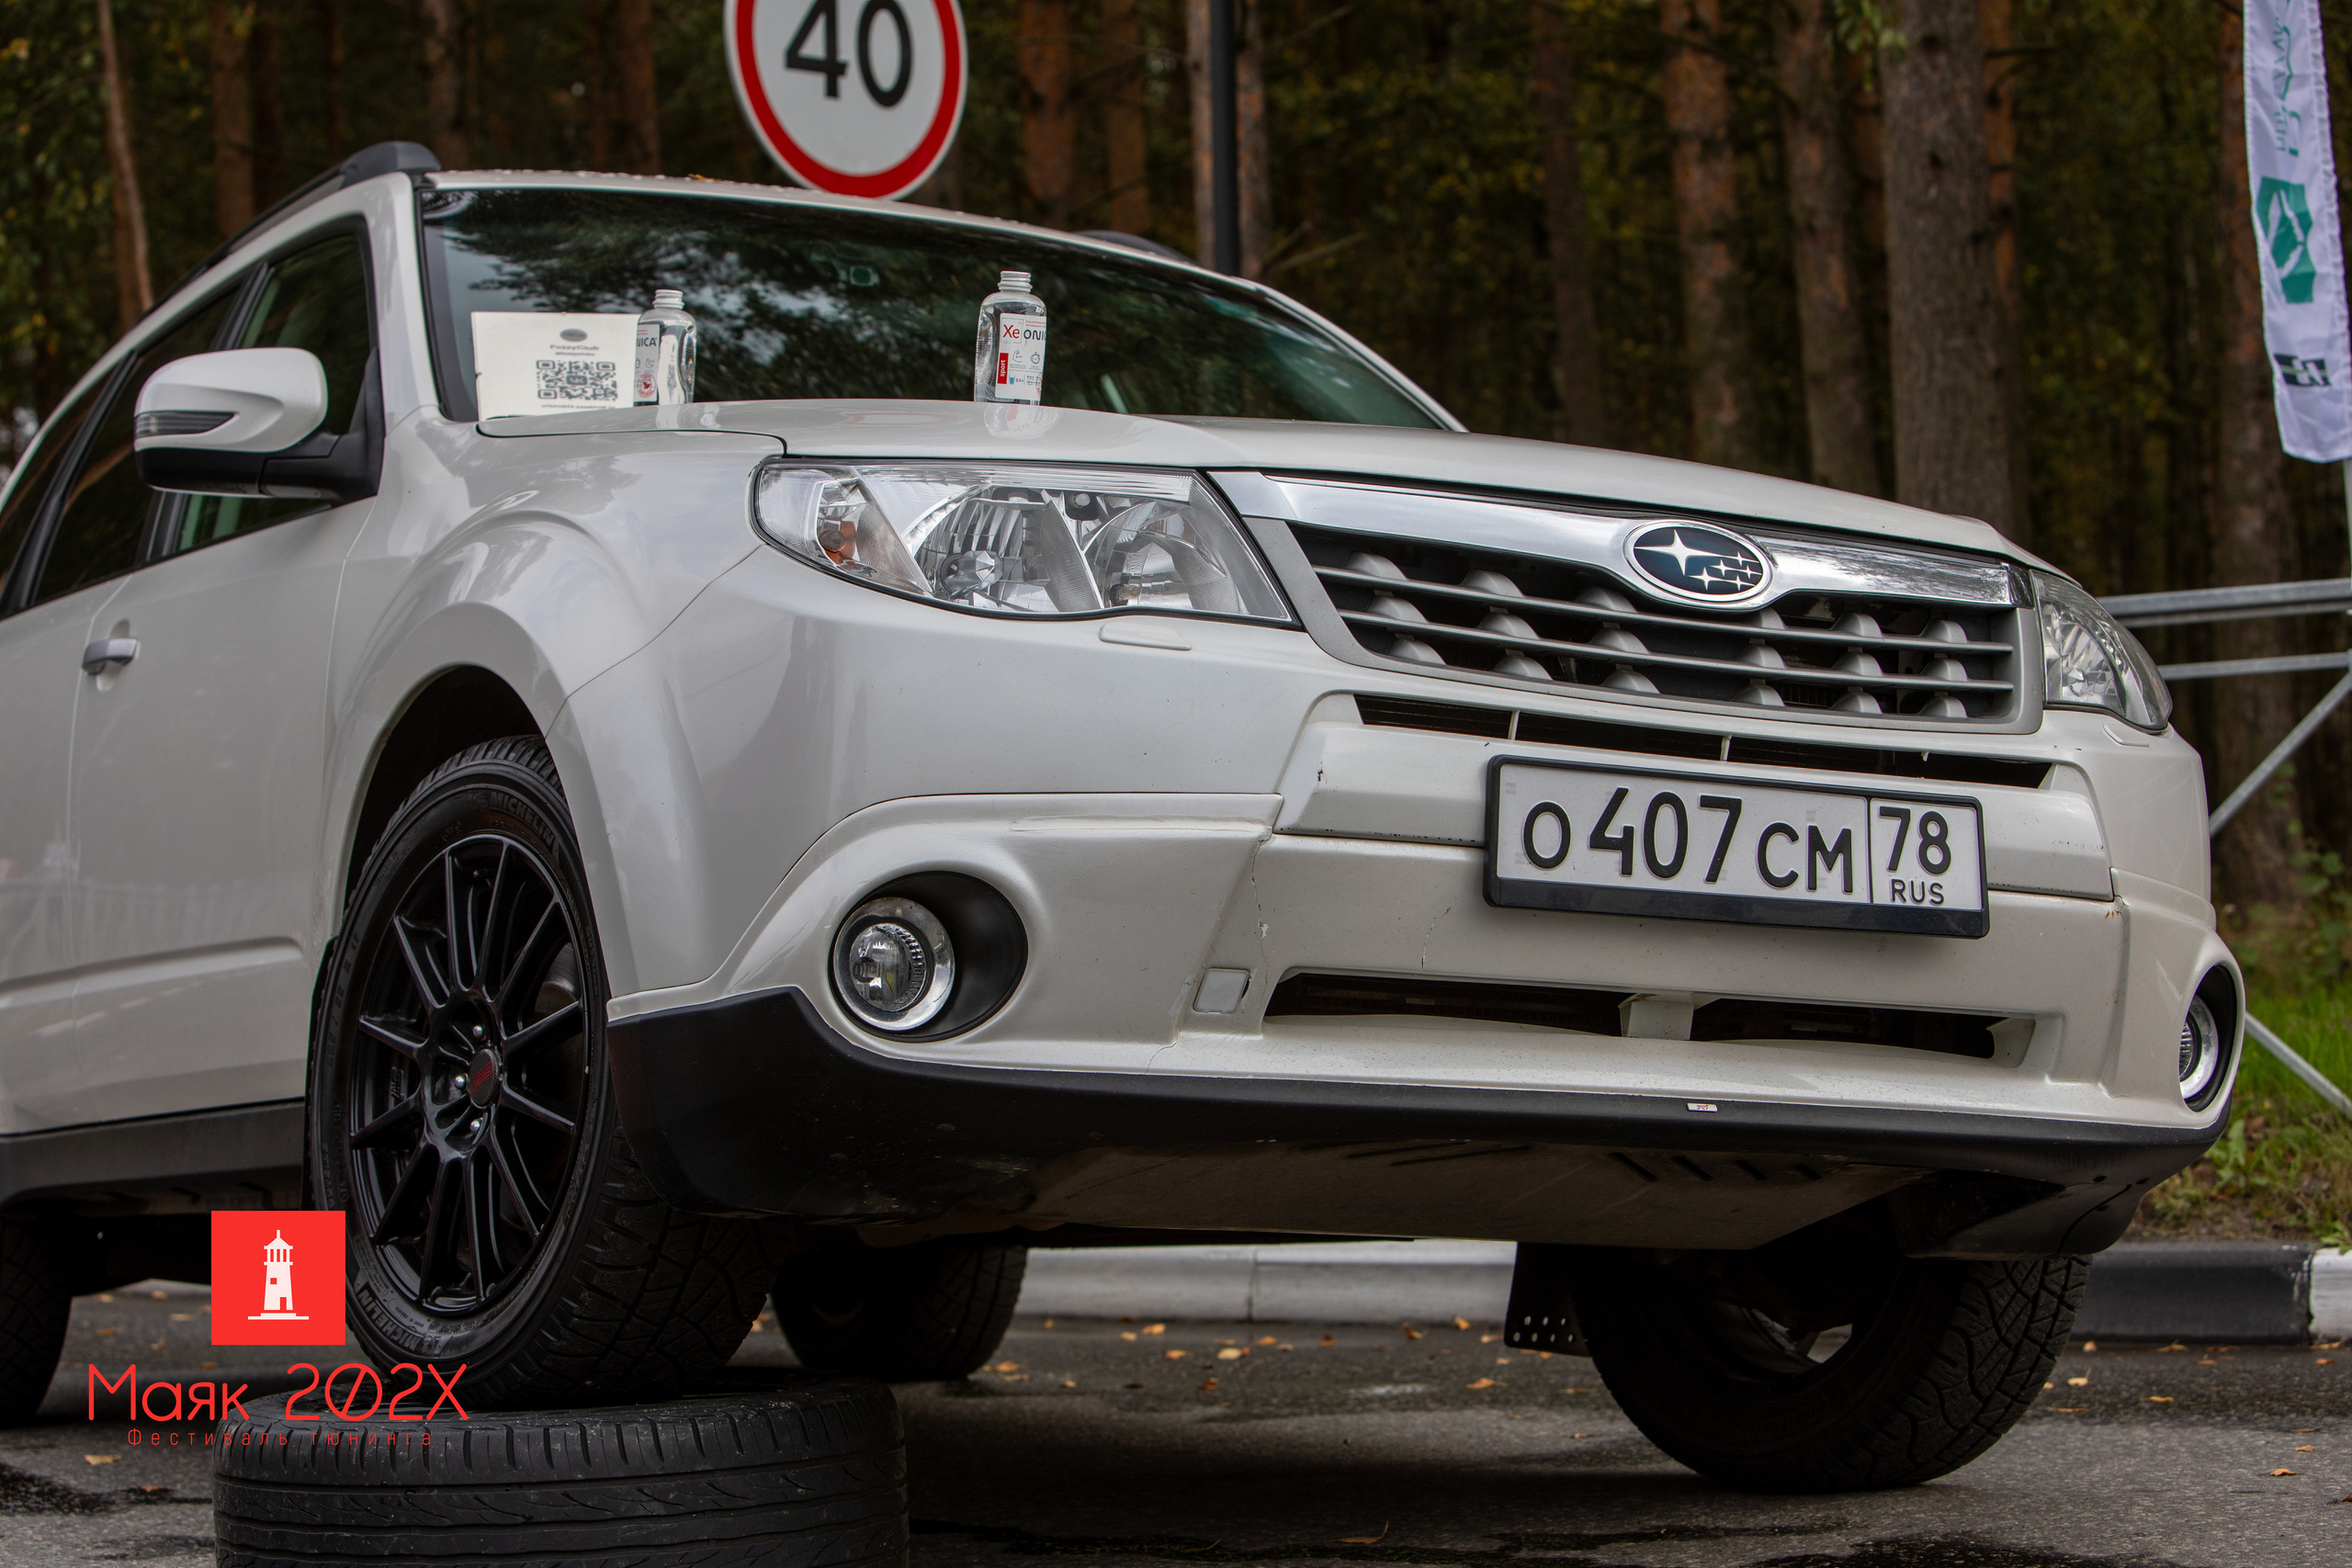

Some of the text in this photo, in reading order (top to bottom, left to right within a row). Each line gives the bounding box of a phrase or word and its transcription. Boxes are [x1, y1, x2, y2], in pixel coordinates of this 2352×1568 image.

[785, 0, 913, 108] 40
[1002, 324, 1020, 339] Xe
[490, 791, 556, 847] MICHELIN
[1589, 786, 1743, 884] 407
[1879, 806, 1951, 875] 78
[1891, 878, 1945, 906] RUS
[357, 1288, 421, 1351] MICHELIN
